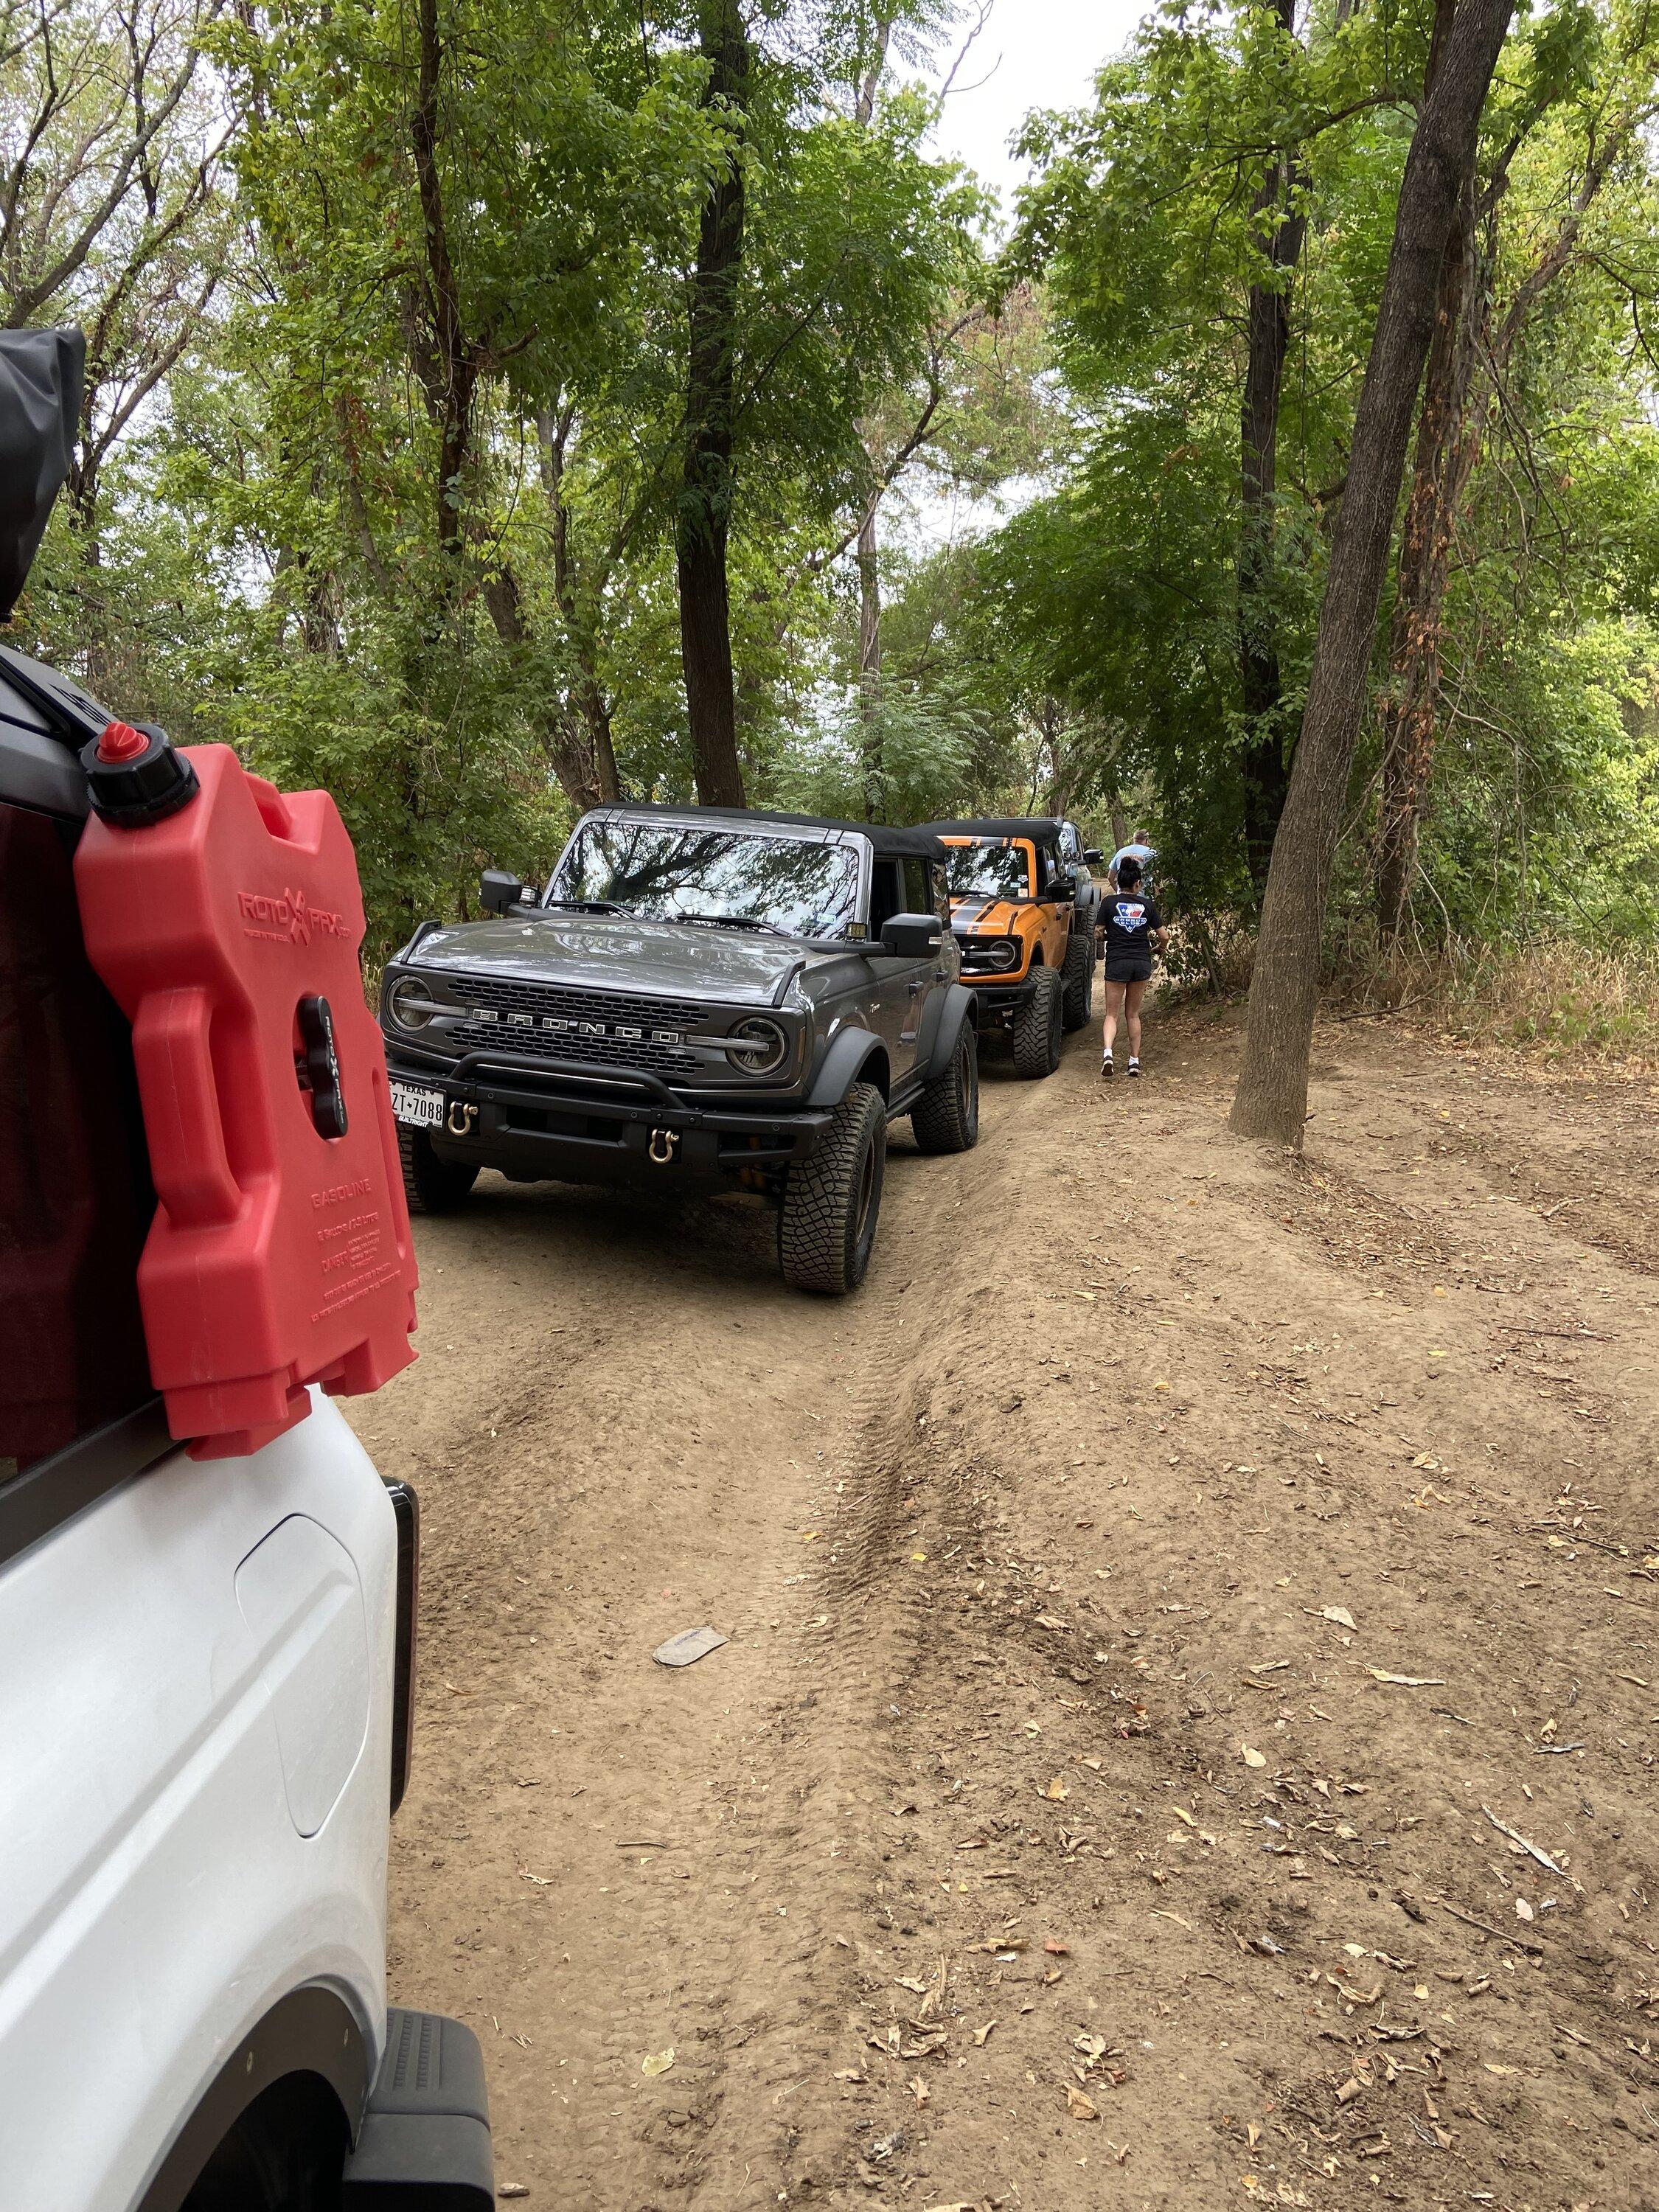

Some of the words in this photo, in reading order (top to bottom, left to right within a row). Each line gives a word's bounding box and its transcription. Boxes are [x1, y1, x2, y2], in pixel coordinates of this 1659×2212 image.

[473, 1009, 679, 1043] BRONCO
[402, 1085, 426, 1096] TEXAS
[310, 1178, 372, 1208] GASOLINE
